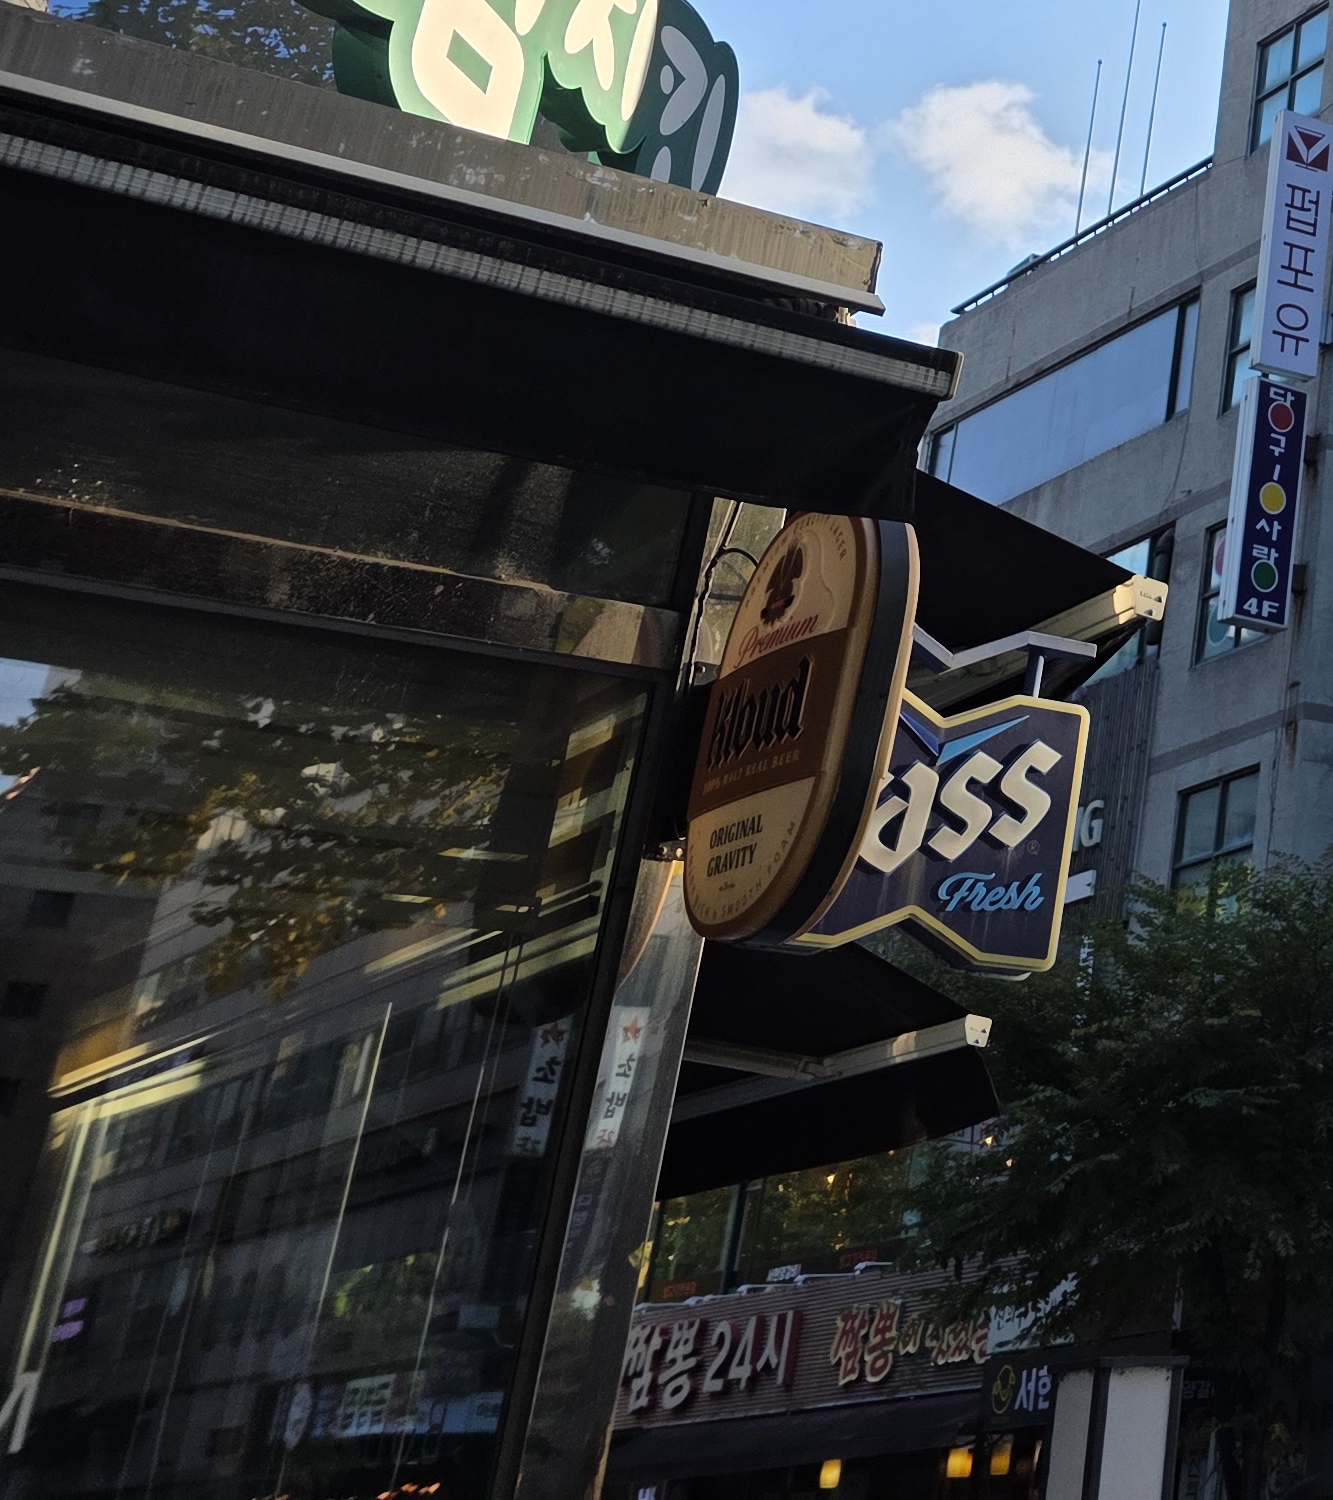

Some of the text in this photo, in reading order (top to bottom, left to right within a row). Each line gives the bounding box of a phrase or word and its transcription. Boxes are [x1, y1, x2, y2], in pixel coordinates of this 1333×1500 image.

[1272, 183, 1319, 357] 펍포유
[1243, 597, 1280, 617] 4F
[736, 610, 819, 669] Premium
[771, 748, 801, 768] BEER
[859, 740, 1064, 874] ass
[709, 814, 763, 850] ORIGINAL
[706, 843, 759, 878] GRAVITY
[937, 871, 1045, 913] Fresh
